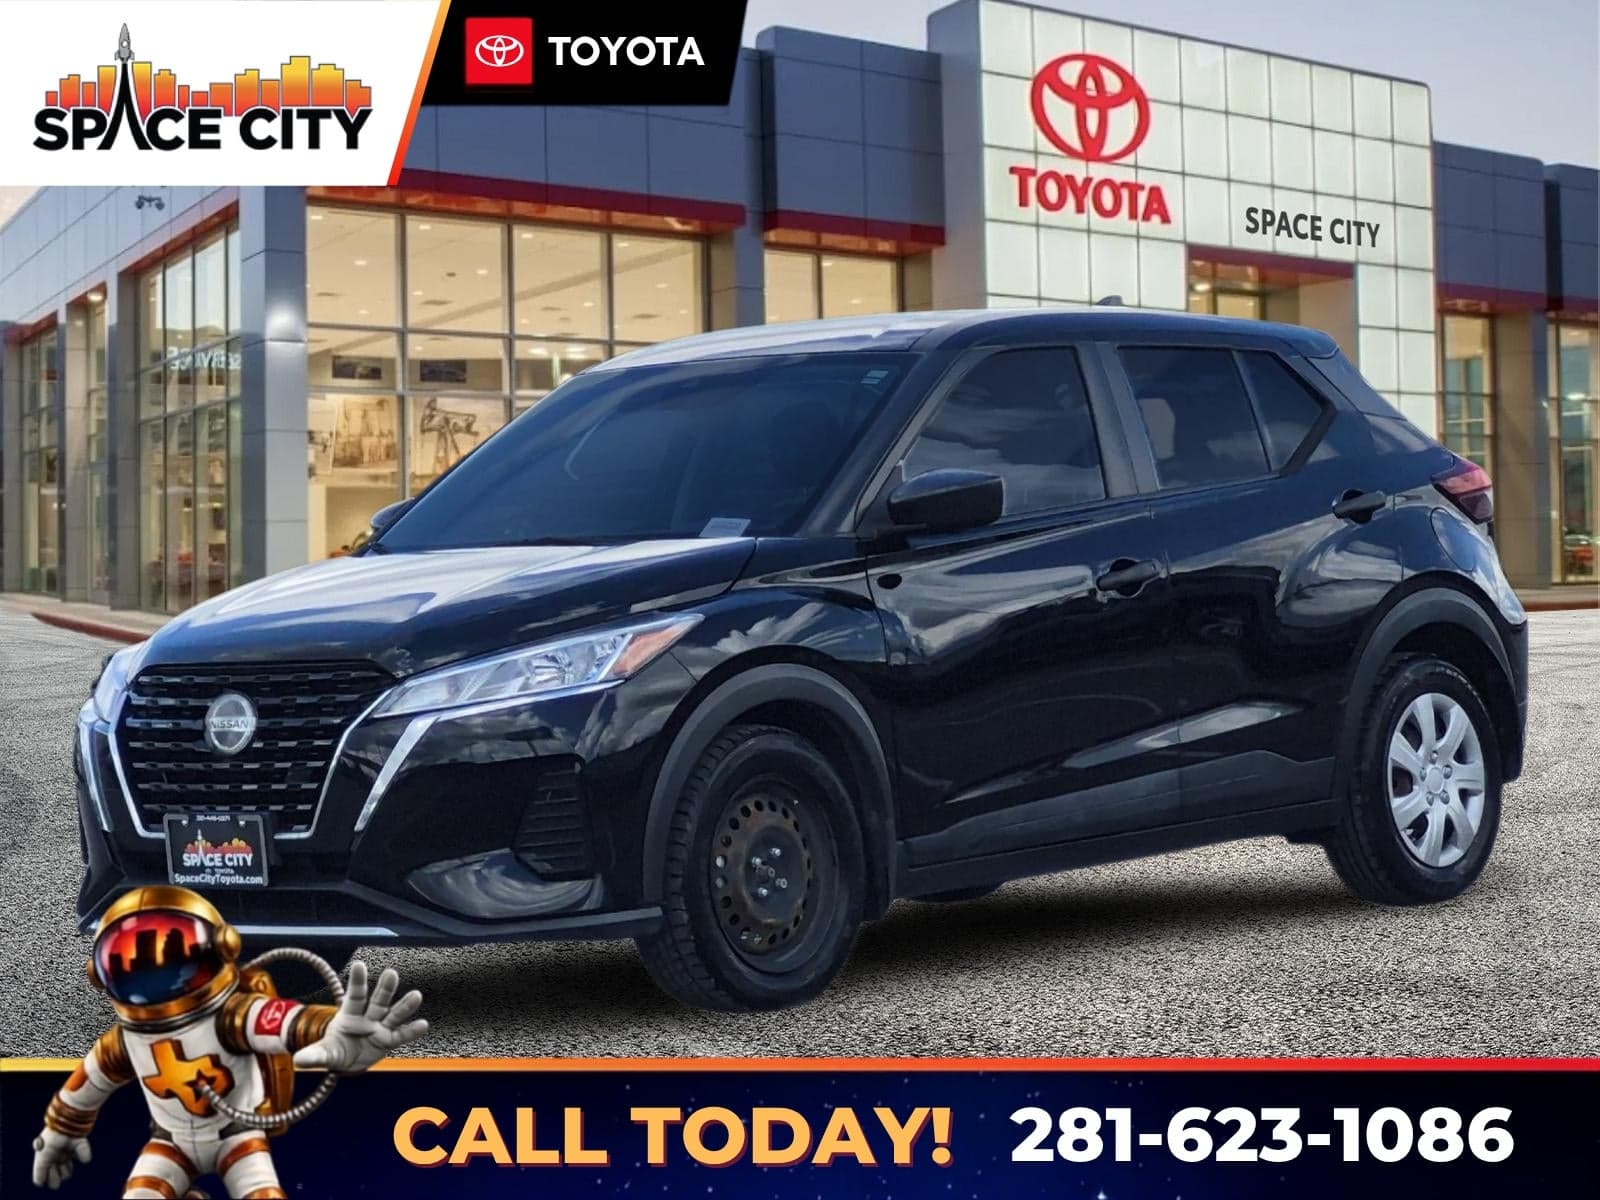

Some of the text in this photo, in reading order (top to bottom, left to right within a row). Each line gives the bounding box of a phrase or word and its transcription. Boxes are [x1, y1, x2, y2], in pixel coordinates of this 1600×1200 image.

[1009, 165, 1171, 225] TOYOTA
[1245, 206, 1381, 249] SPACE CITY
[209, 719, 249, 729] NISSAN
[182, 852, 254, 867] SPACE CITY
[174, 872, 264, 886] SpaceCityToyota.com
